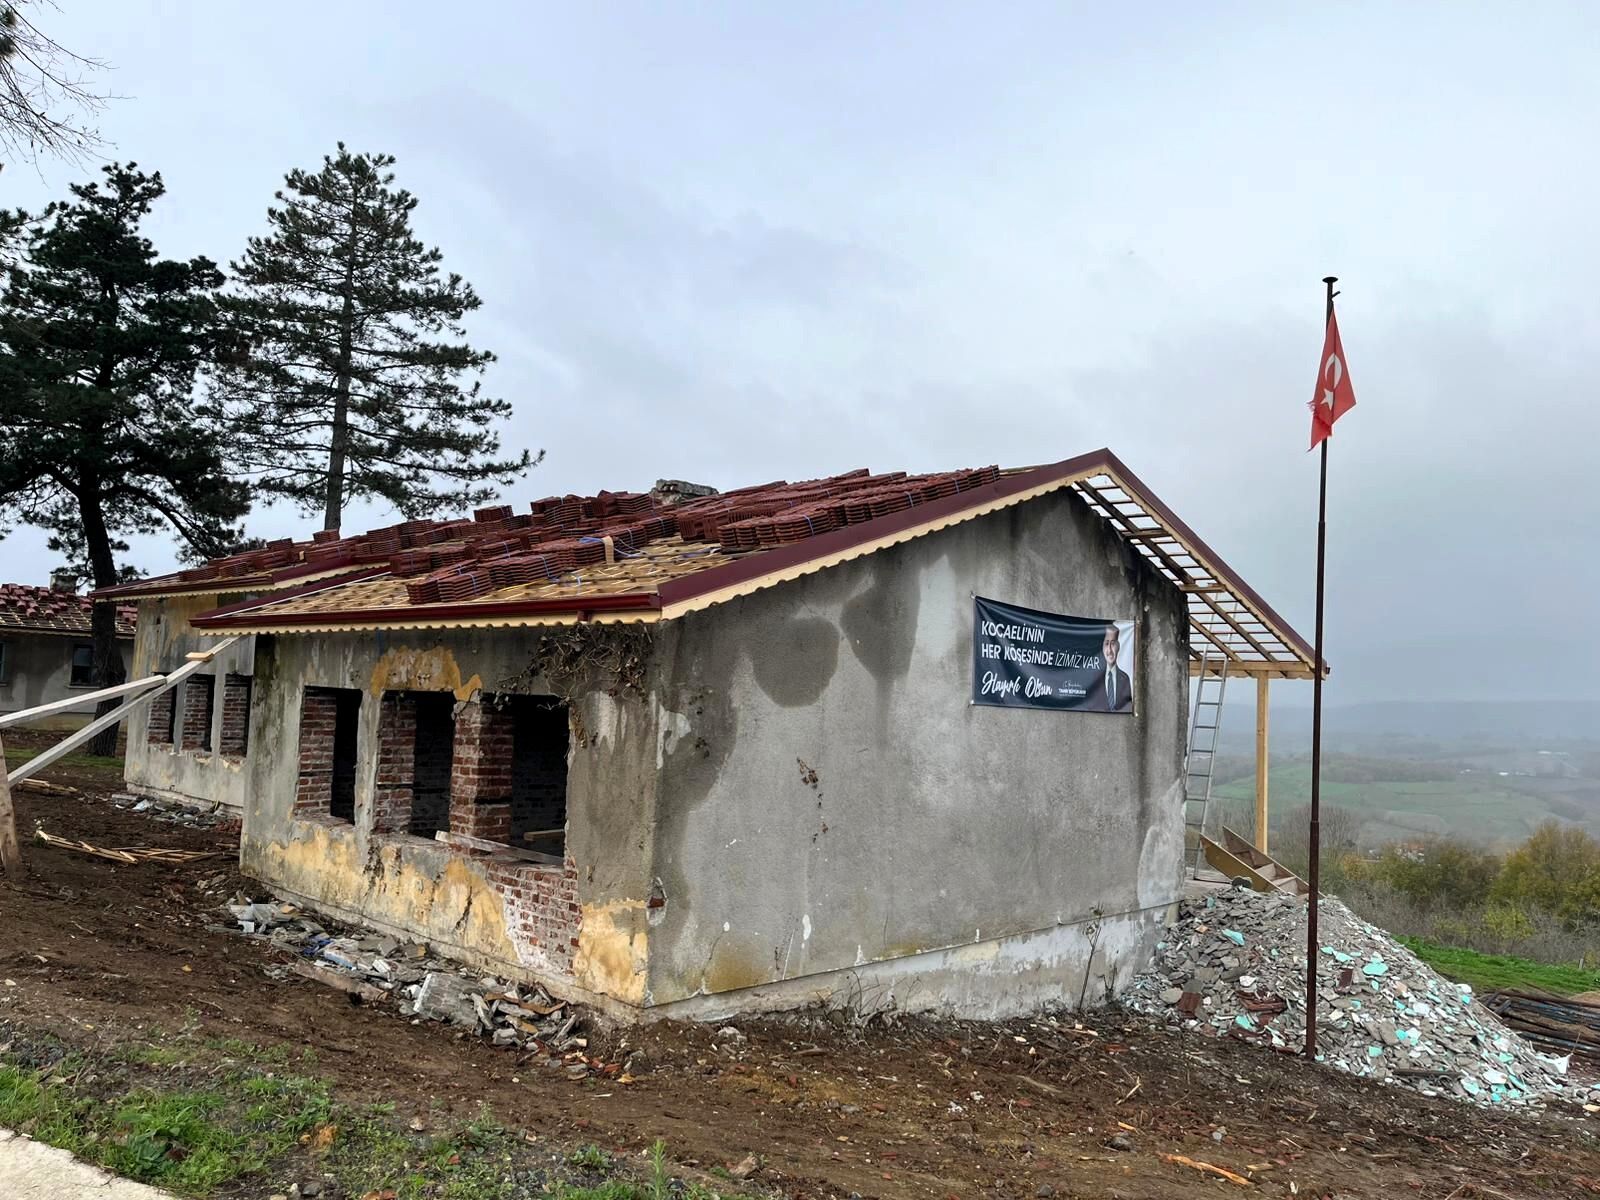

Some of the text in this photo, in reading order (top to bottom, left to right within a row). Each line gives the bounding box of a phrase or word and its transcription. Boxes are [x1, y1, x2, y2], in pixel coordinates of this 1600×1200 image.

[981, 621, 1045, 643] KOCAELİ'NİN
[981, 643, 1100, 670] HER KÖŞESİNDE İZİMİZ VAR
[1025, 676, 1053, 698] Olsun
